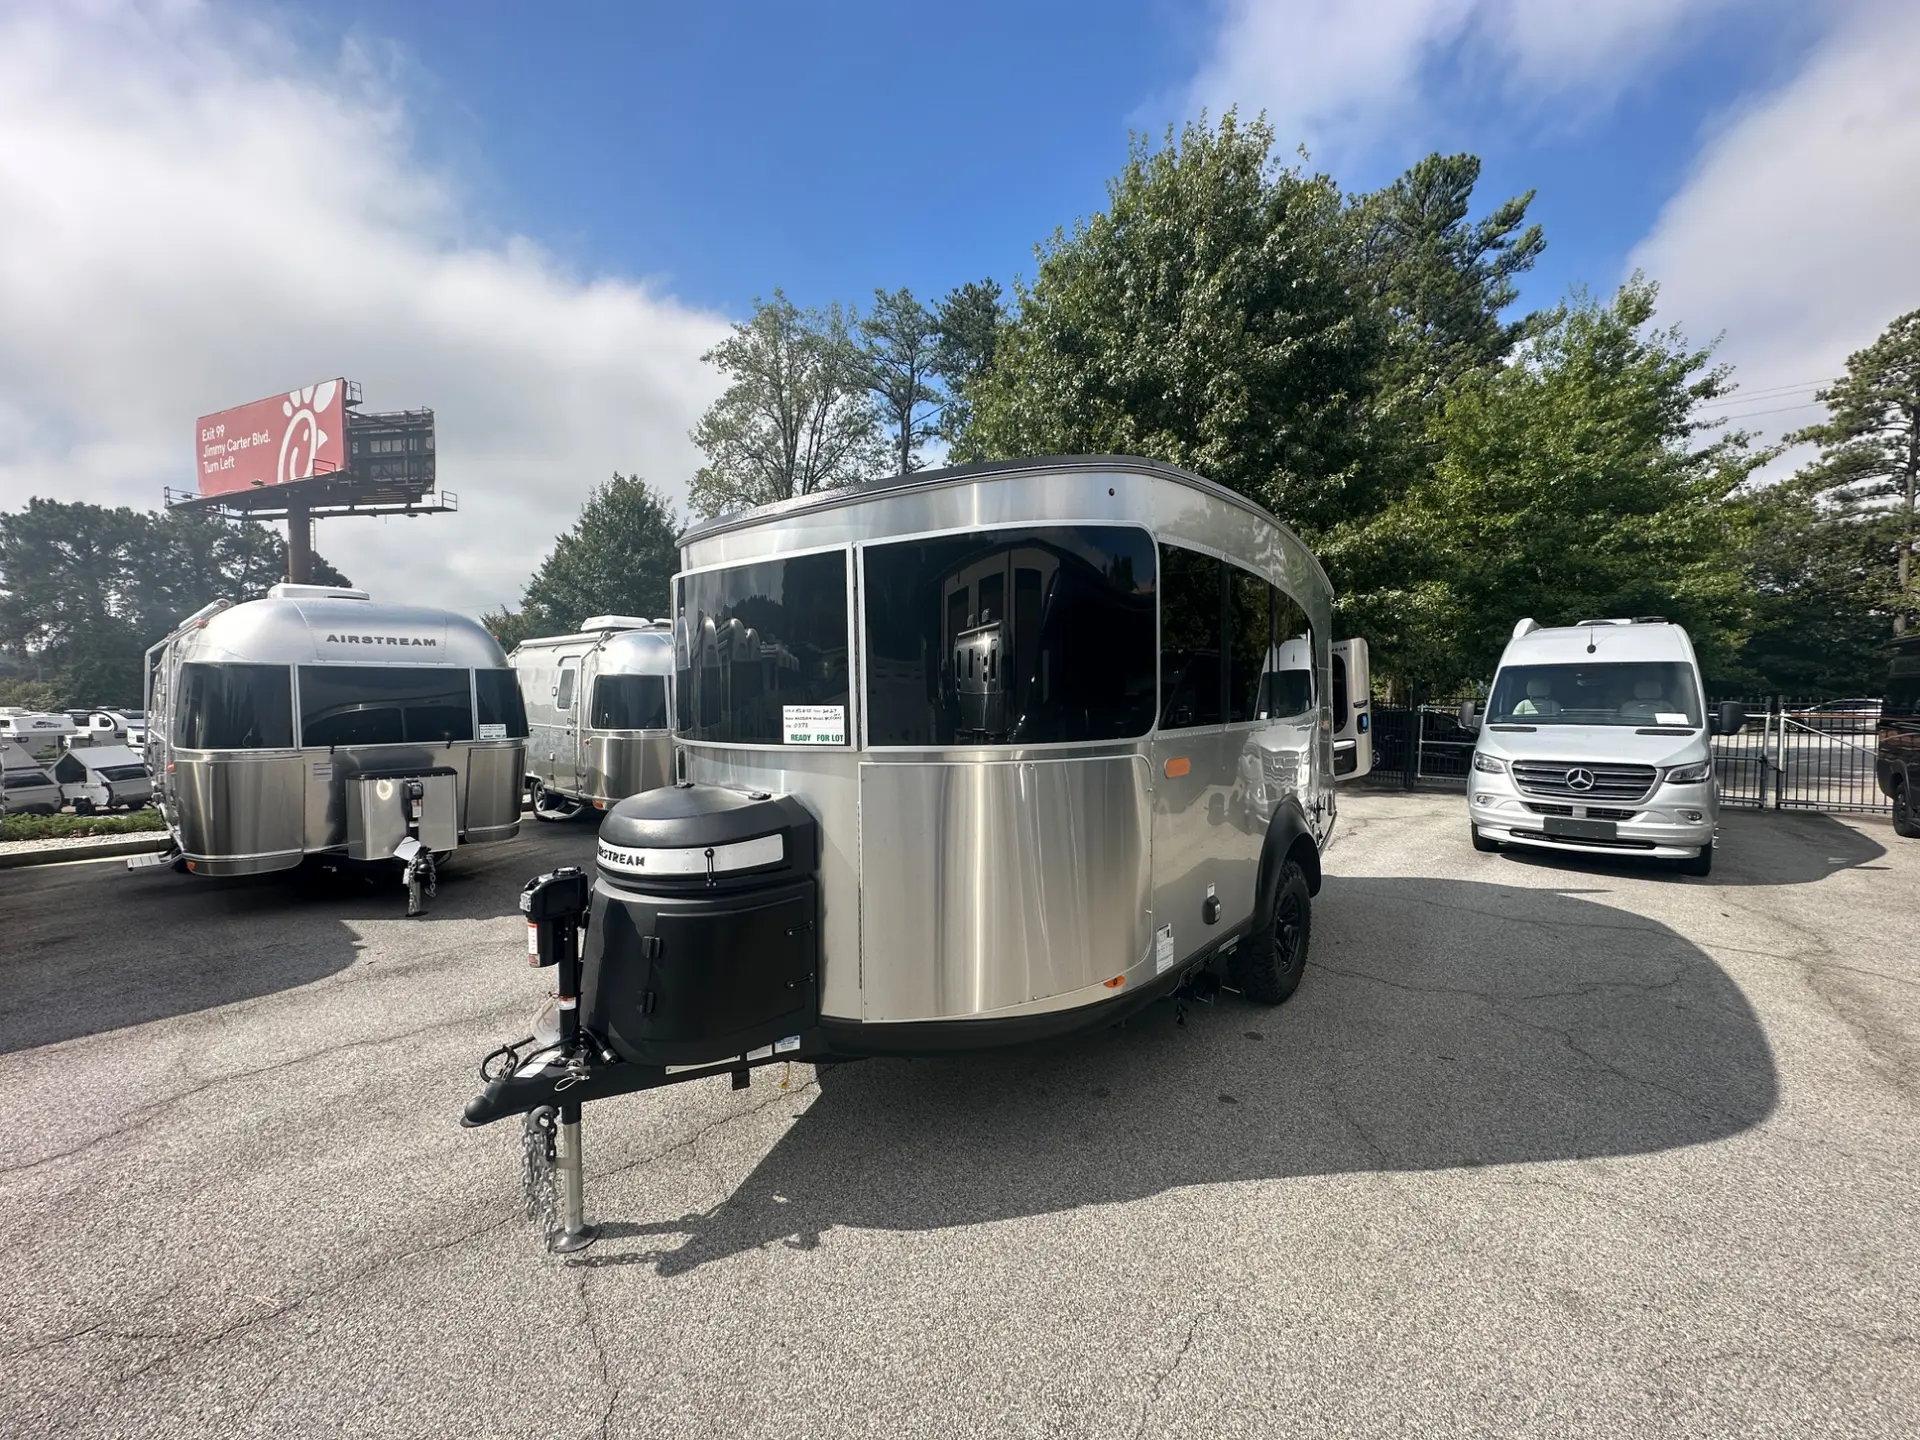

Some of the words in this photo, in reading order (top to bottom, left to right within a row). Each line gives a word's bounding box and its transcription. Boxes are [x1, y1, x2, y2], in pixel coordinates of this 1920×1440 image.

[202, 427, 215, 442] Exit
[216, 424, 225, 437] 99
[203, 443, 226, 458] Jimmy
[227, 436, 252, 452] Carter
[252, 429, 271, 446] Blvd.
[203, 461, 219, 474] Turn
[220, 456, 235, 470] Left
[326, 634, 437, 647] AIRSTREAM
[791, 734, 811, 742] READY
[817, 734, 830, 742] FOR
[831, 734, 844, 742] LOT
